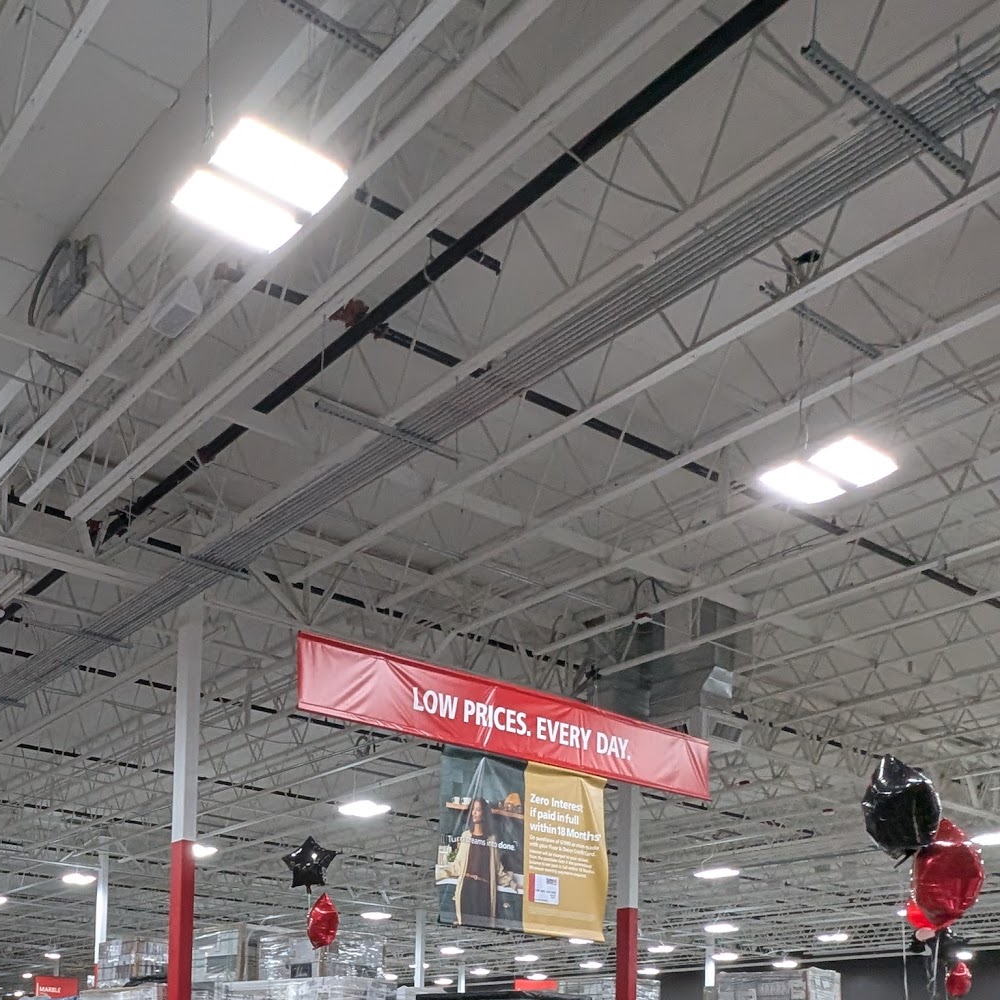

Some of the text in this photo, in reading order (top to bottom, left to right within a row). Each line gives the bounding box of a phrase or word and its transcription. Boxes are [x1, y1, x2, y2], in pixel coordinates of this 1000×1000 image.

[411, 686, 631, 761] LOW PRICES. EVERY DAY.
[530, 793, 583, 813] Zero Interest
[530, 807, 579, 825] if paid in full
[529, 822, 557, 835] within
[557, 826, 566, 836] 18
[447, 835, 466, 843] Turn
[486, 840, 497, 848] into
[498, 841, 516, 851] done.
